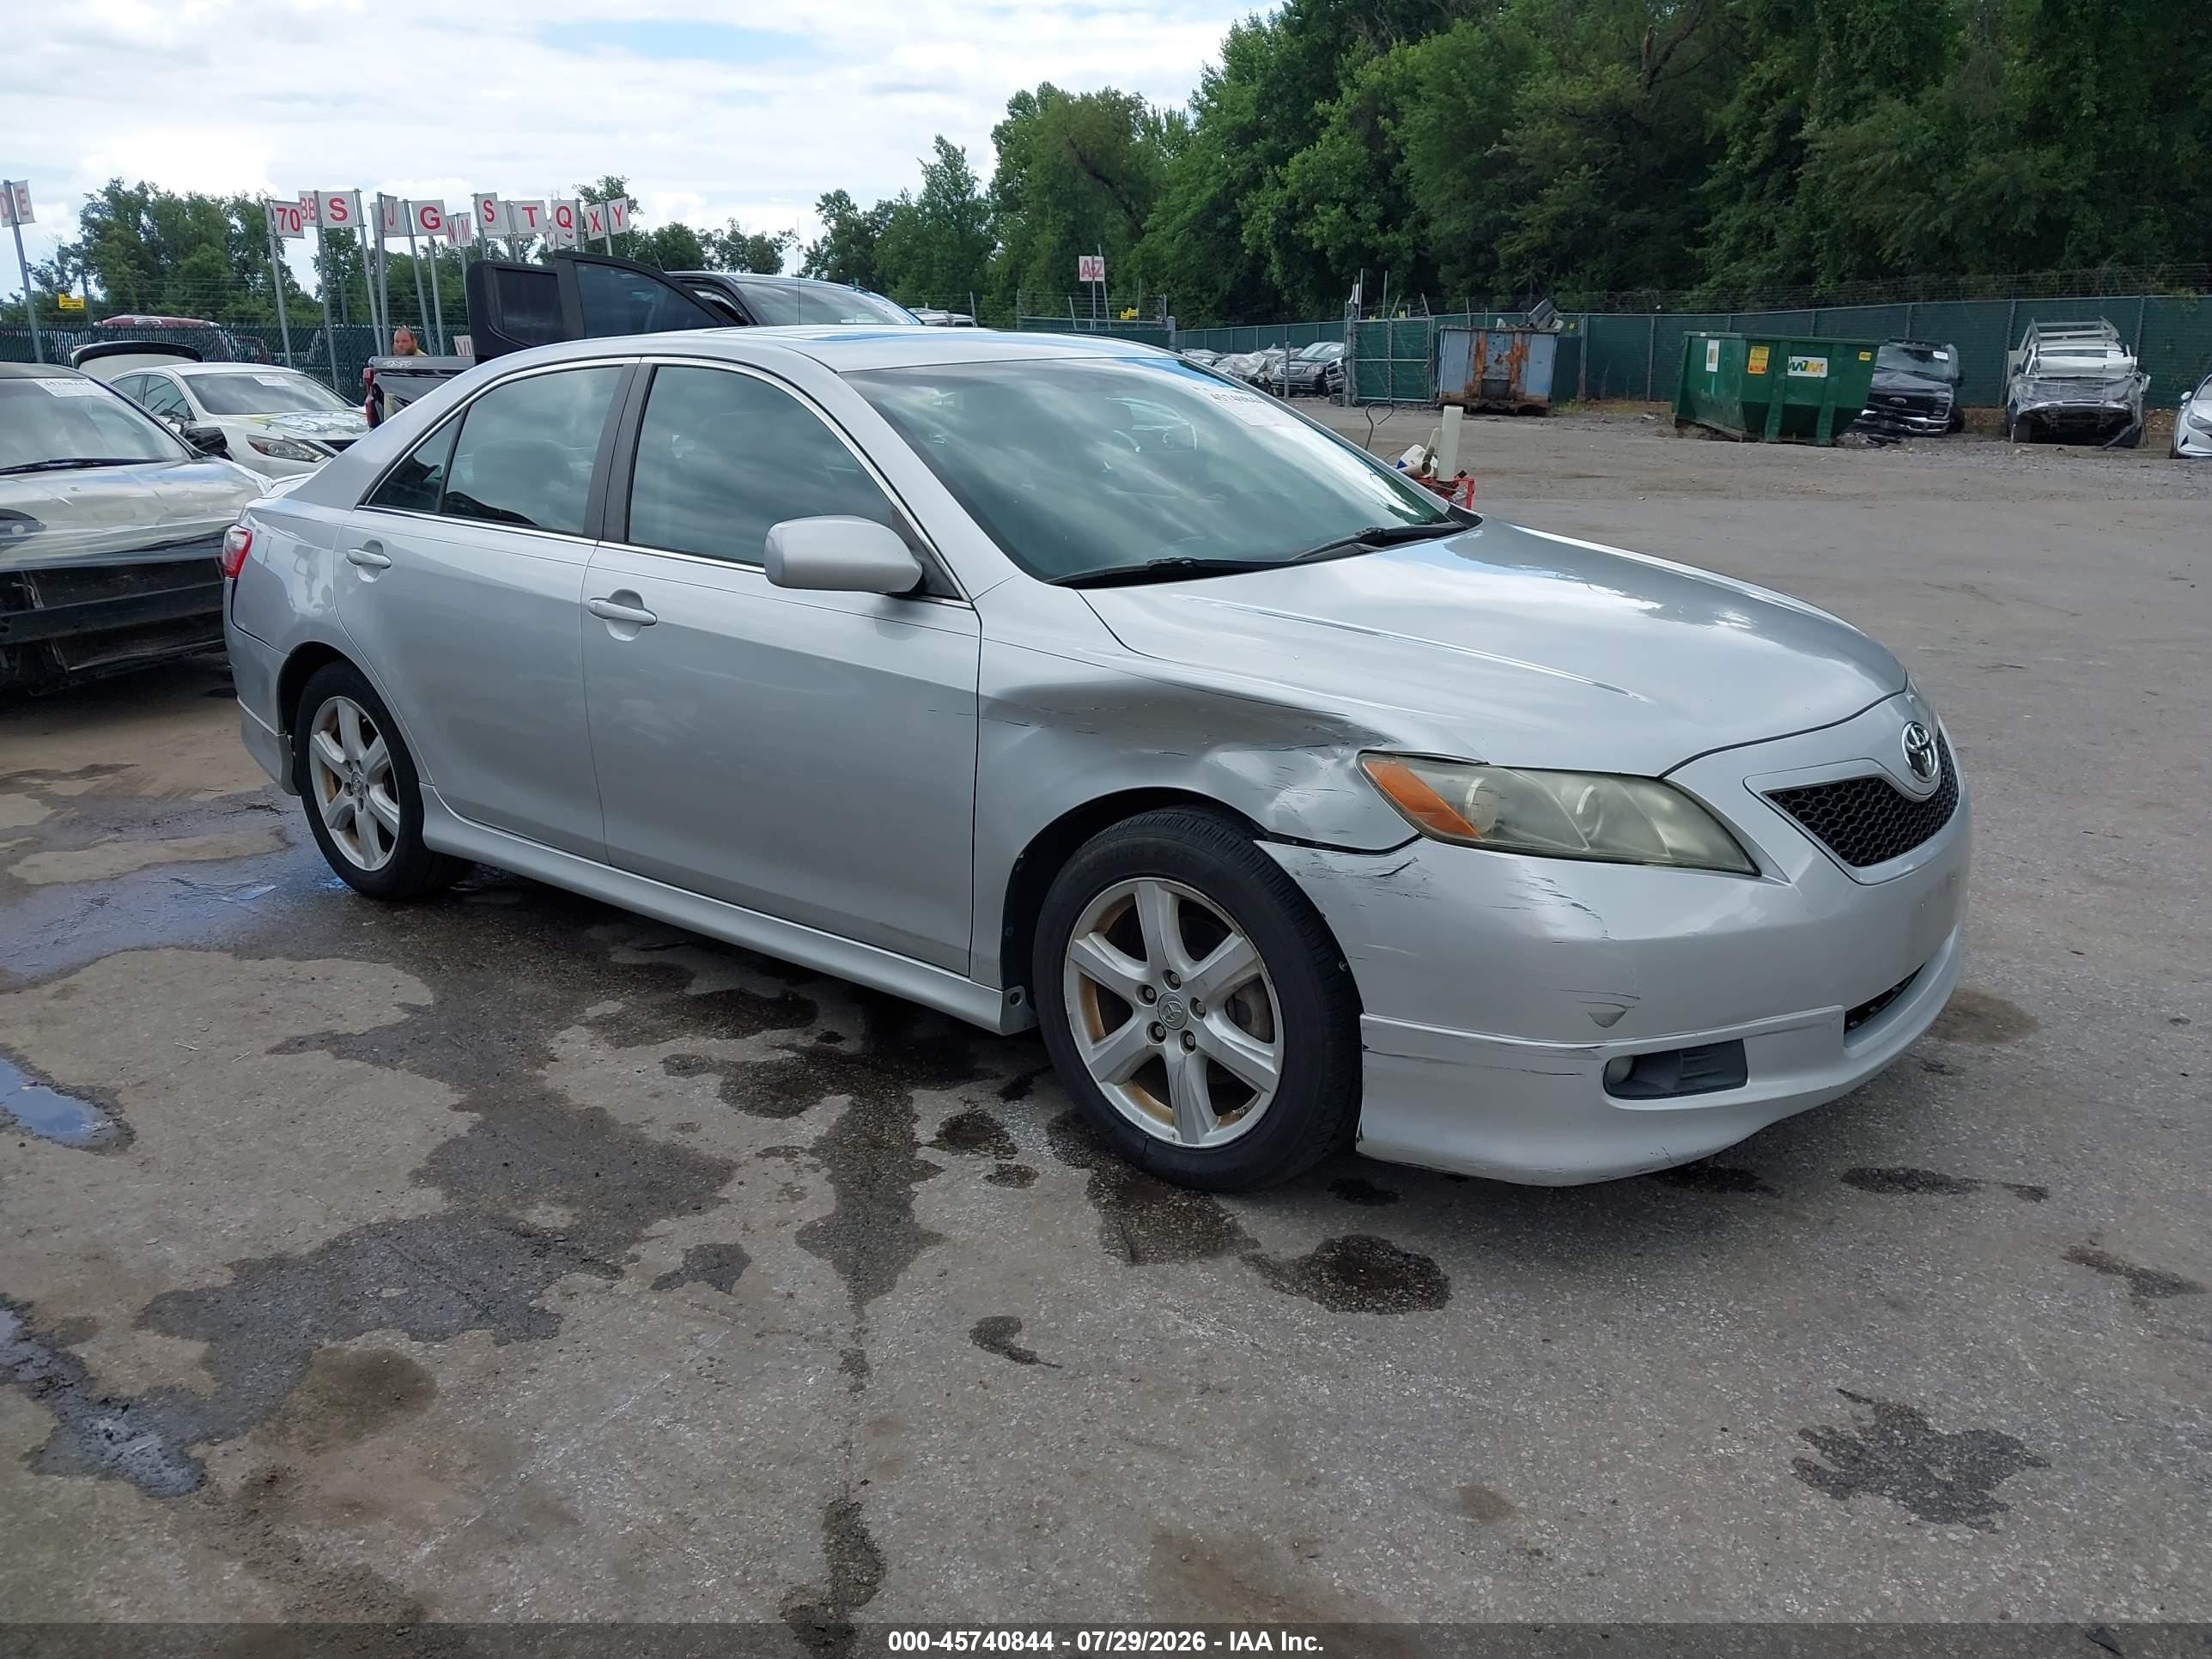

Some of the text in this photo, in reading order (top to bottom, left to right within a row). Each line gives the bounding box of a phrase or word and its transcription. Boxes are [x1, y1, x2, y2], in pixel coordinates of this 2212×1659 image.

[17, 188, 29, 216] E
[329, 197, 348, 222] S
[483, 199, 495, 223] S
[276, 207, 301, 233] 70
[387, 203, 395, 226] J
[419, 206, 441, 230] G
[522, 206, 538, 228] T
[556, 205, 573, 229] Q
[589, 210, 603, 234] X
[612, 204, 623, 228] Y
[447, 220, 456, 244] N
